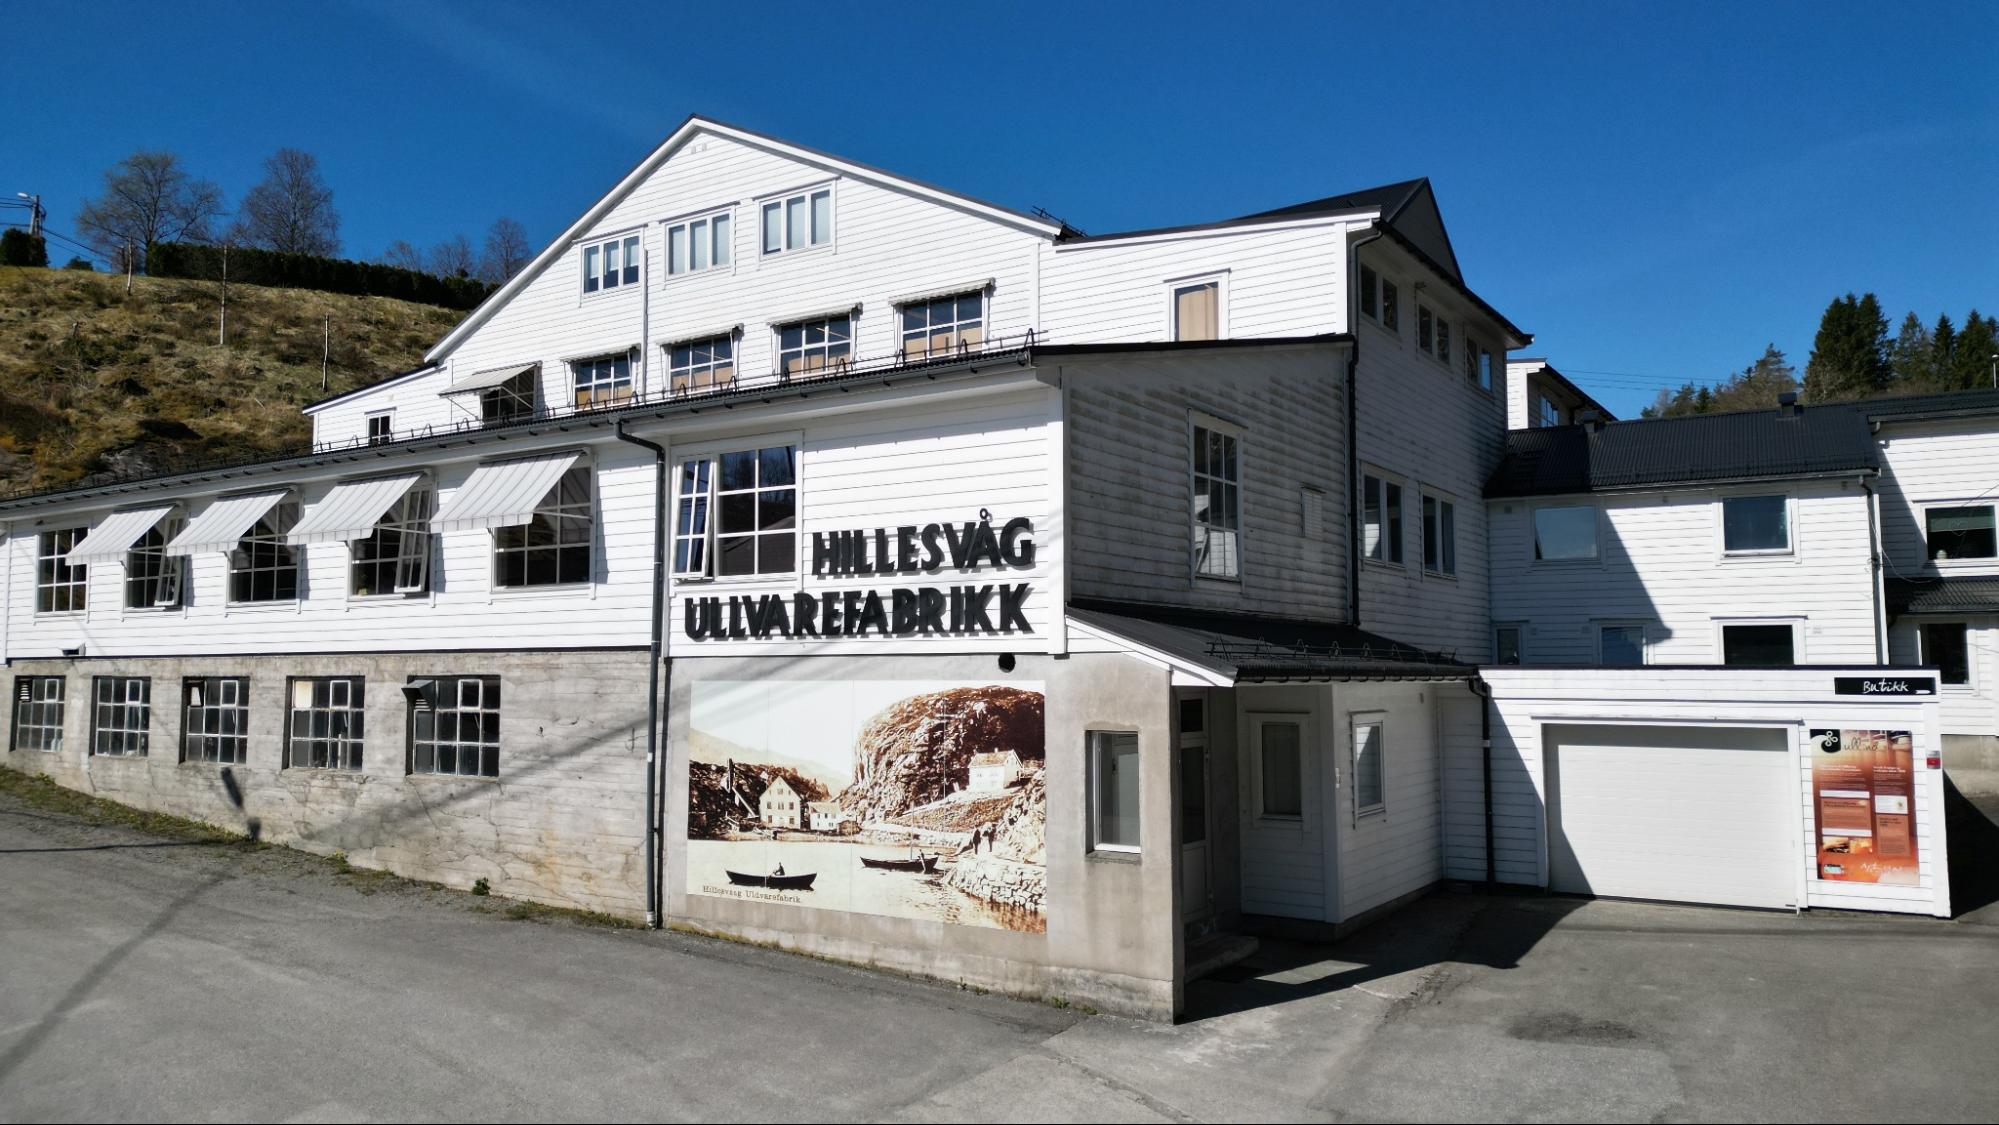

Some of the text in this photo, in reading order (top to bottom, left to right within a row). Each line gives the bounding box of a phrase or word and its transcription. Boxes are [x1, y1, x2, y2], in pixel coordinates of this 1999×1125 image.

[812, 508, 1034, 576] HILLESVÅG
[684, 583, 1034, 640] ULLVAREFABRIKK
[1863, 678, 1909, 694] Butikk
